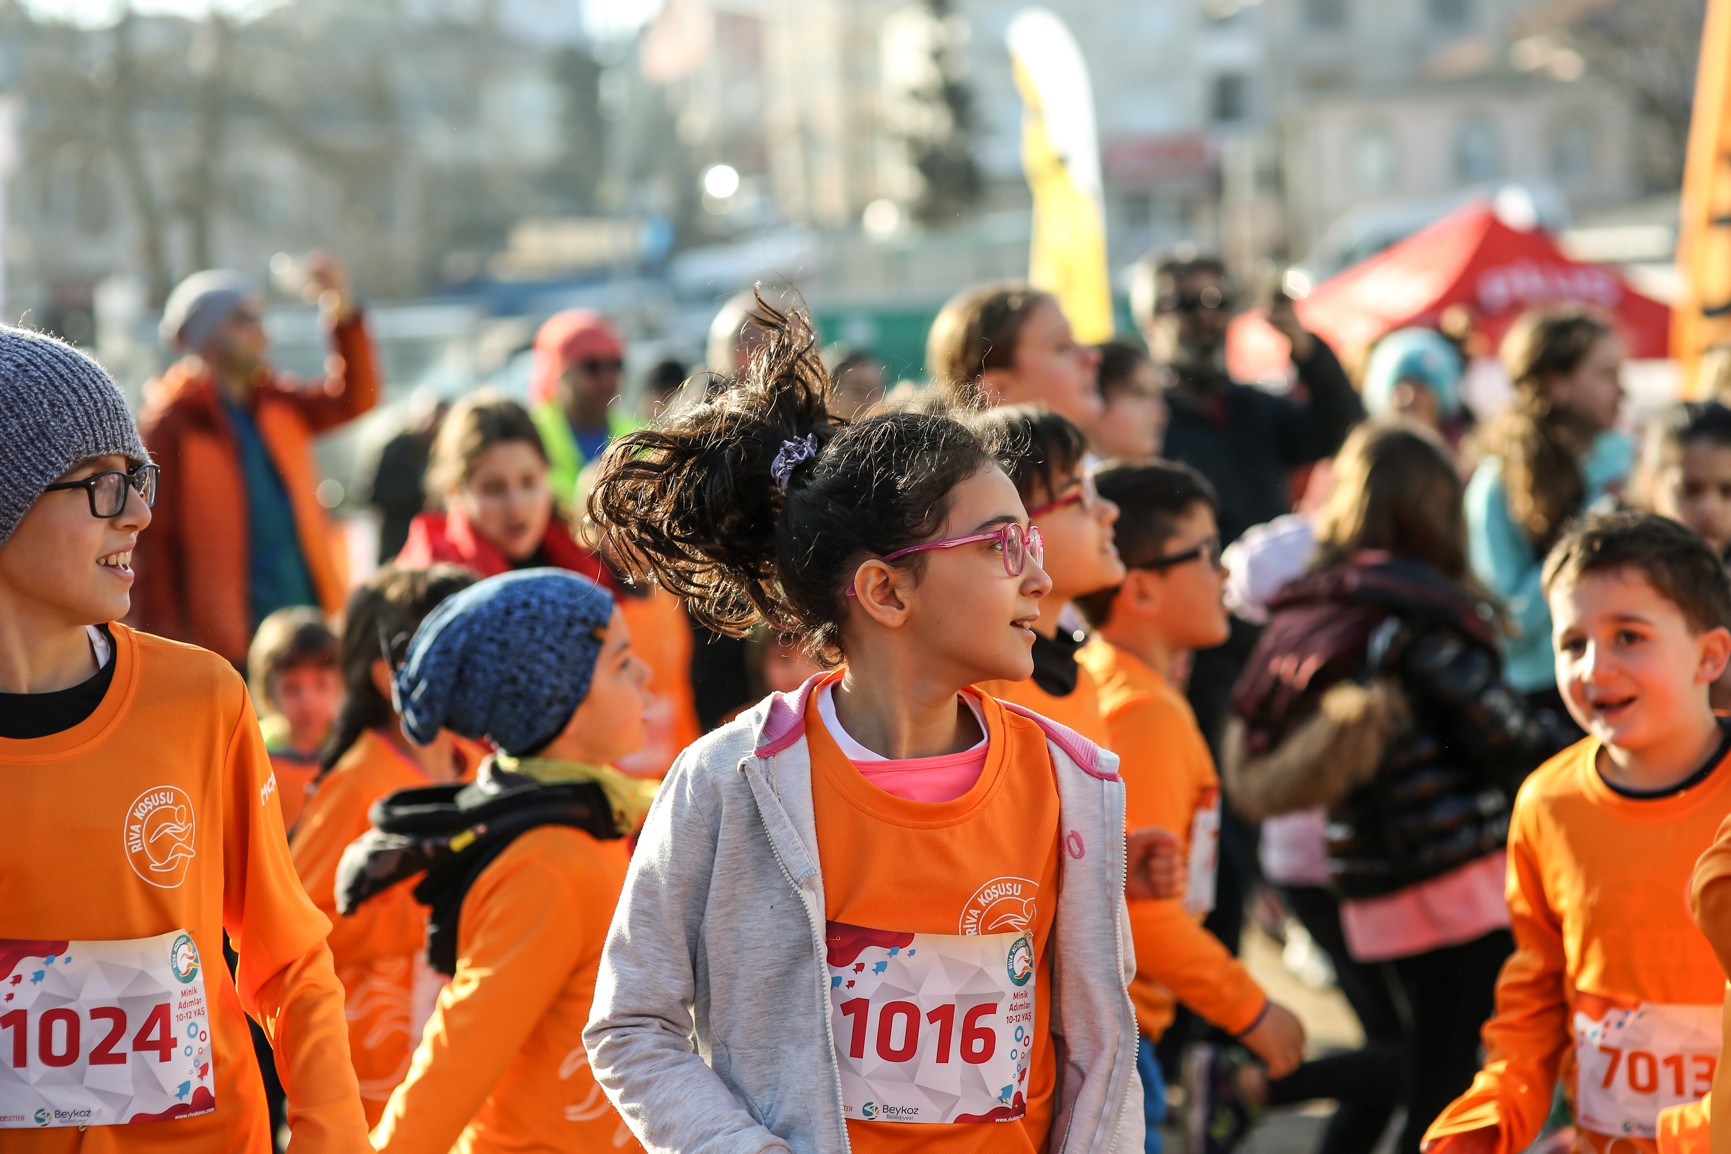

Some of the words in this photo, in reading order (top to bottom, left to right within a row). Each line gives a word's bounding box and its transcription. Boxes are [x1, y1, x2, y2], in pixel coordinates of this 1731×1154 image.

[133, 791, 174, 820] KOŞUSU
[977, 882, 1022, 907] KOŞUSU
[181, 986, 198, 998] Minik
[1013, 990, 1028, 1000] Minik
[176, 1011, 193, 1022] 10-12
[1006, 1014, 1021, 1024] 10-12
[0, 1003, 178, 1069] 1024
[840, 997, 998, 1065] 1016
[1598, 1046, 1718, 1100] 7013
[54, 1108, 92, 1119] Beykoz
[882, 1104, 919, 1115] Beykoz
